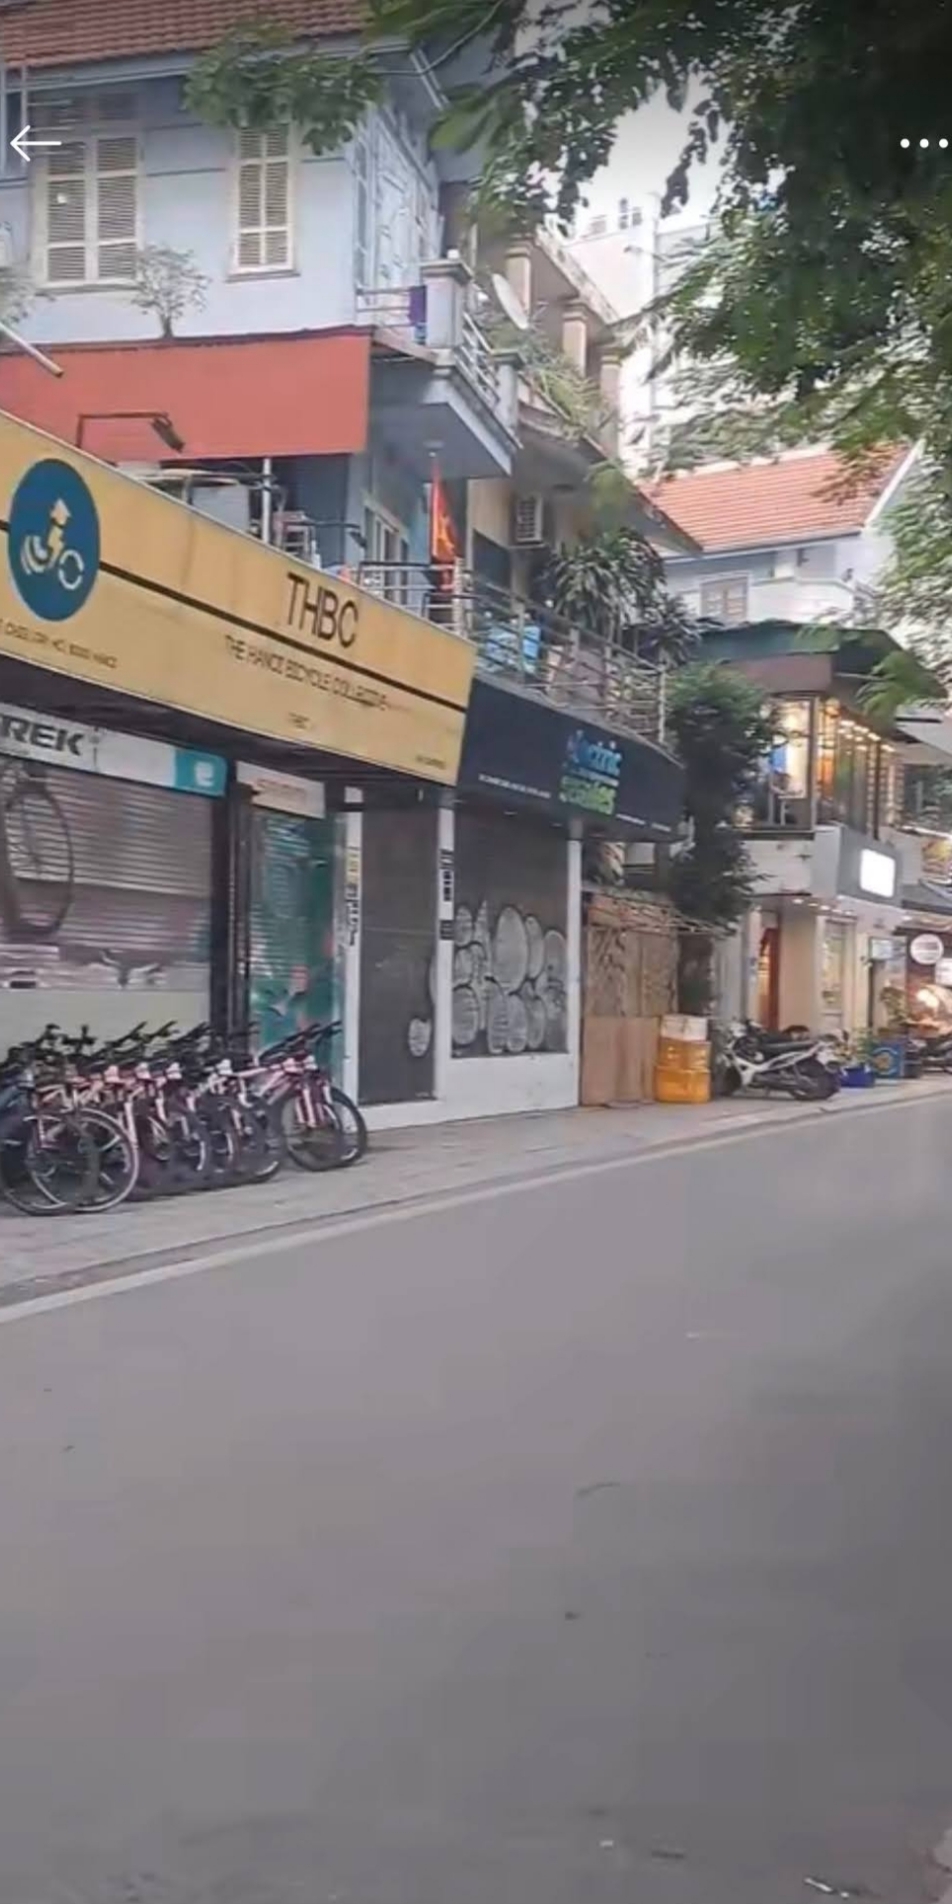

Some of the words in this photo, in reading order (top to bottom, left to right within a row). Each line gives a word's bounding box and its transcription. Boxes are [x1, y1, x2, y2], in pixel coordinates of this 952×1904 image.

[287, 571, 360, 649] THBC
[225, 634, 245, 660] THE
[0, 712, 84, 756] REK
